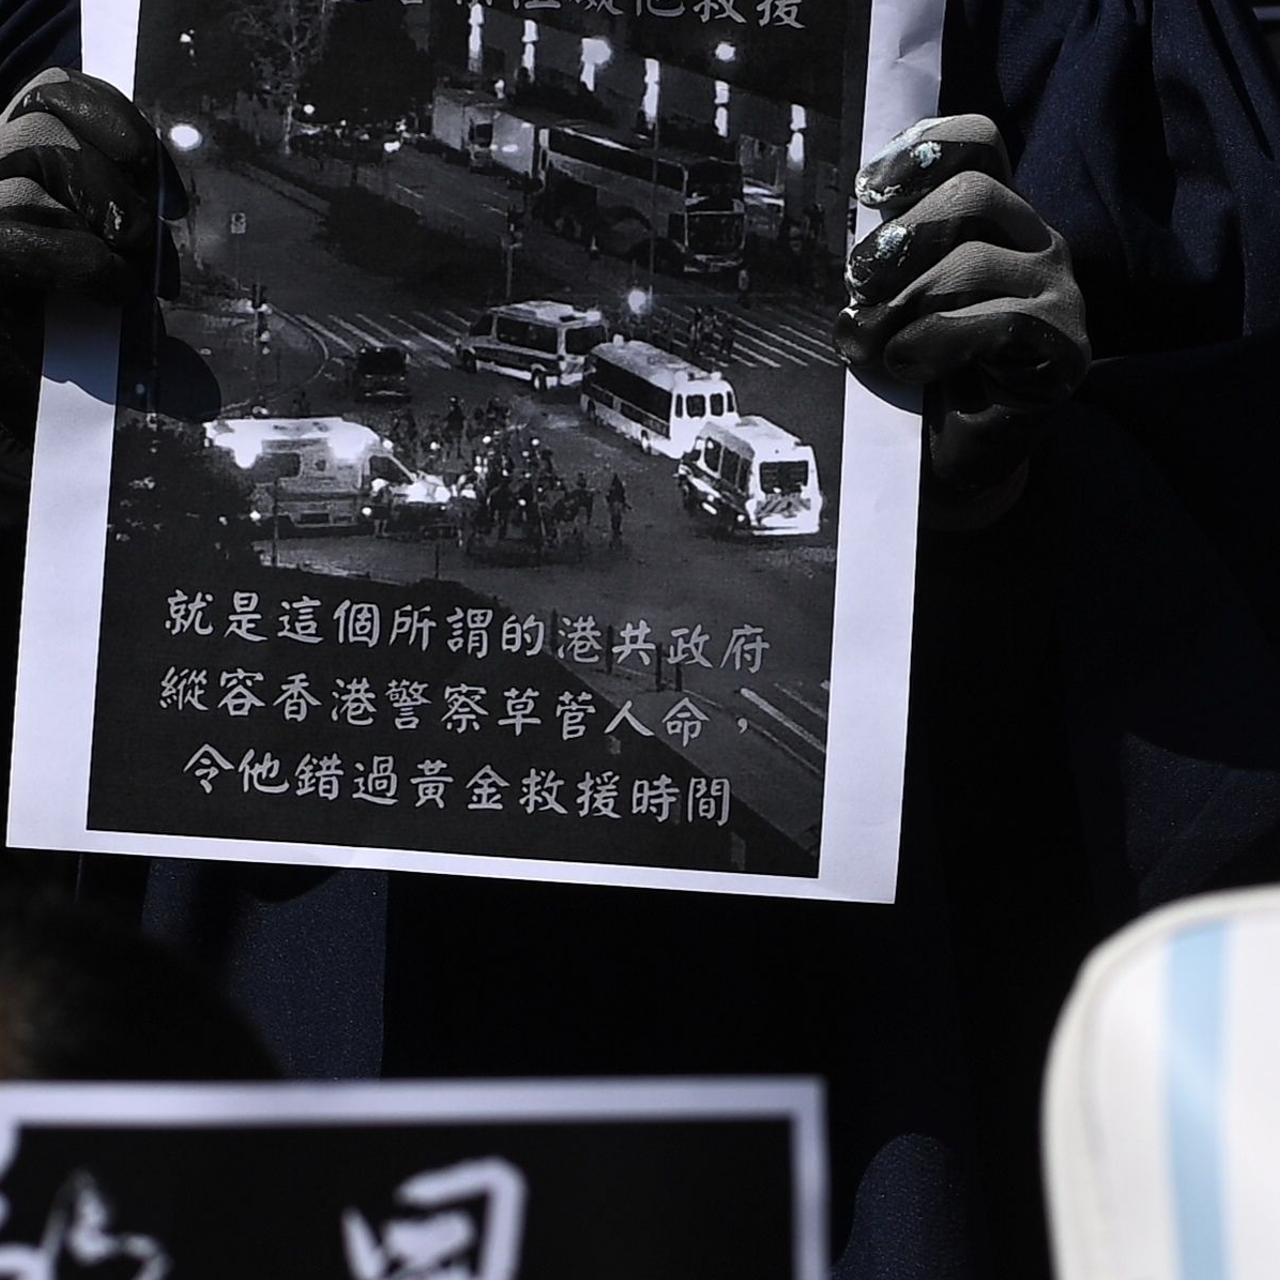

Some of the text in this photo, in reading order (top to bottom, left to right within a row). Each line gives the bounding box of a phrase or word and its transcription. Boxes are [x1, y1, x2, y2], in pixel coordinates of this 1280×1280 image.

[164, 587, 772, 676] 就是這個所謂的港共政府
[182, 742, 733, 828] 令他錯過黃金救援時間
